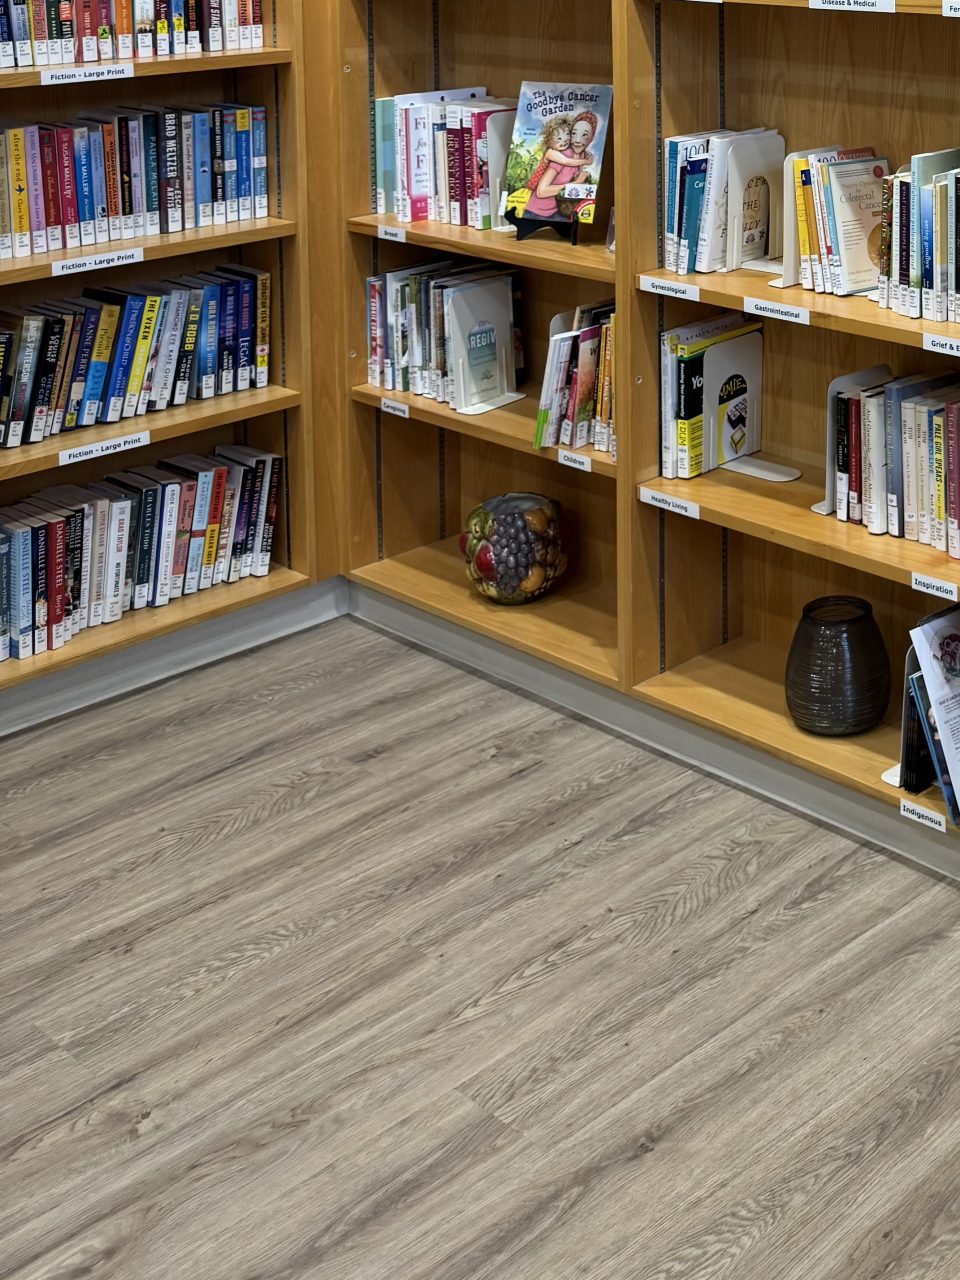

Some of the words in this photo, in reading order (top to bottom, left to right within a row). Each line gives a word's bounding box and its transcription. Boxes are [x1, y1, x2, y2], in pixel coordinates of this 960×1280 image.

[853, 0, 877, 7] Medical
[50, 73, 76, 81] Fiction
[83, 71, 105, 79] Large
[526, 94, 565, 112] Goodbye
[567, 92, 600, 102] Cancer
[533, 91, 546, 99] The
[541, 103, 574, 117] Garden
[165, 113, 176, 137] BRAD
[166, 140, 178, 178] MELTZER
[61, 262, 87, 271] Fiction
[94, 258, 115, 267] Large
[117, 253, 135, 261] Print
[651, 282, 687, 295] Gynecological
[754, 303, 800, 319] Gastrointestinal
[931, 339, 948, 350] Grief
[383, 401, 406, 416] Caregiving
[68, 449, 94, 460] Fiction
[100, 443, 122, 453] Large
[123, 437, 142, 447] Print
[563, 455, 585, 467] Children
[651, 494, 671, 509] Healthy
[672, 500, 688, 514] Living
[55, 523, 64, 568] DANIELLE
[56, 569, 64, 588] STEEL
[914, 577, 953, 596] Inspiration
[902, 805, 942, 827] Indigenous
